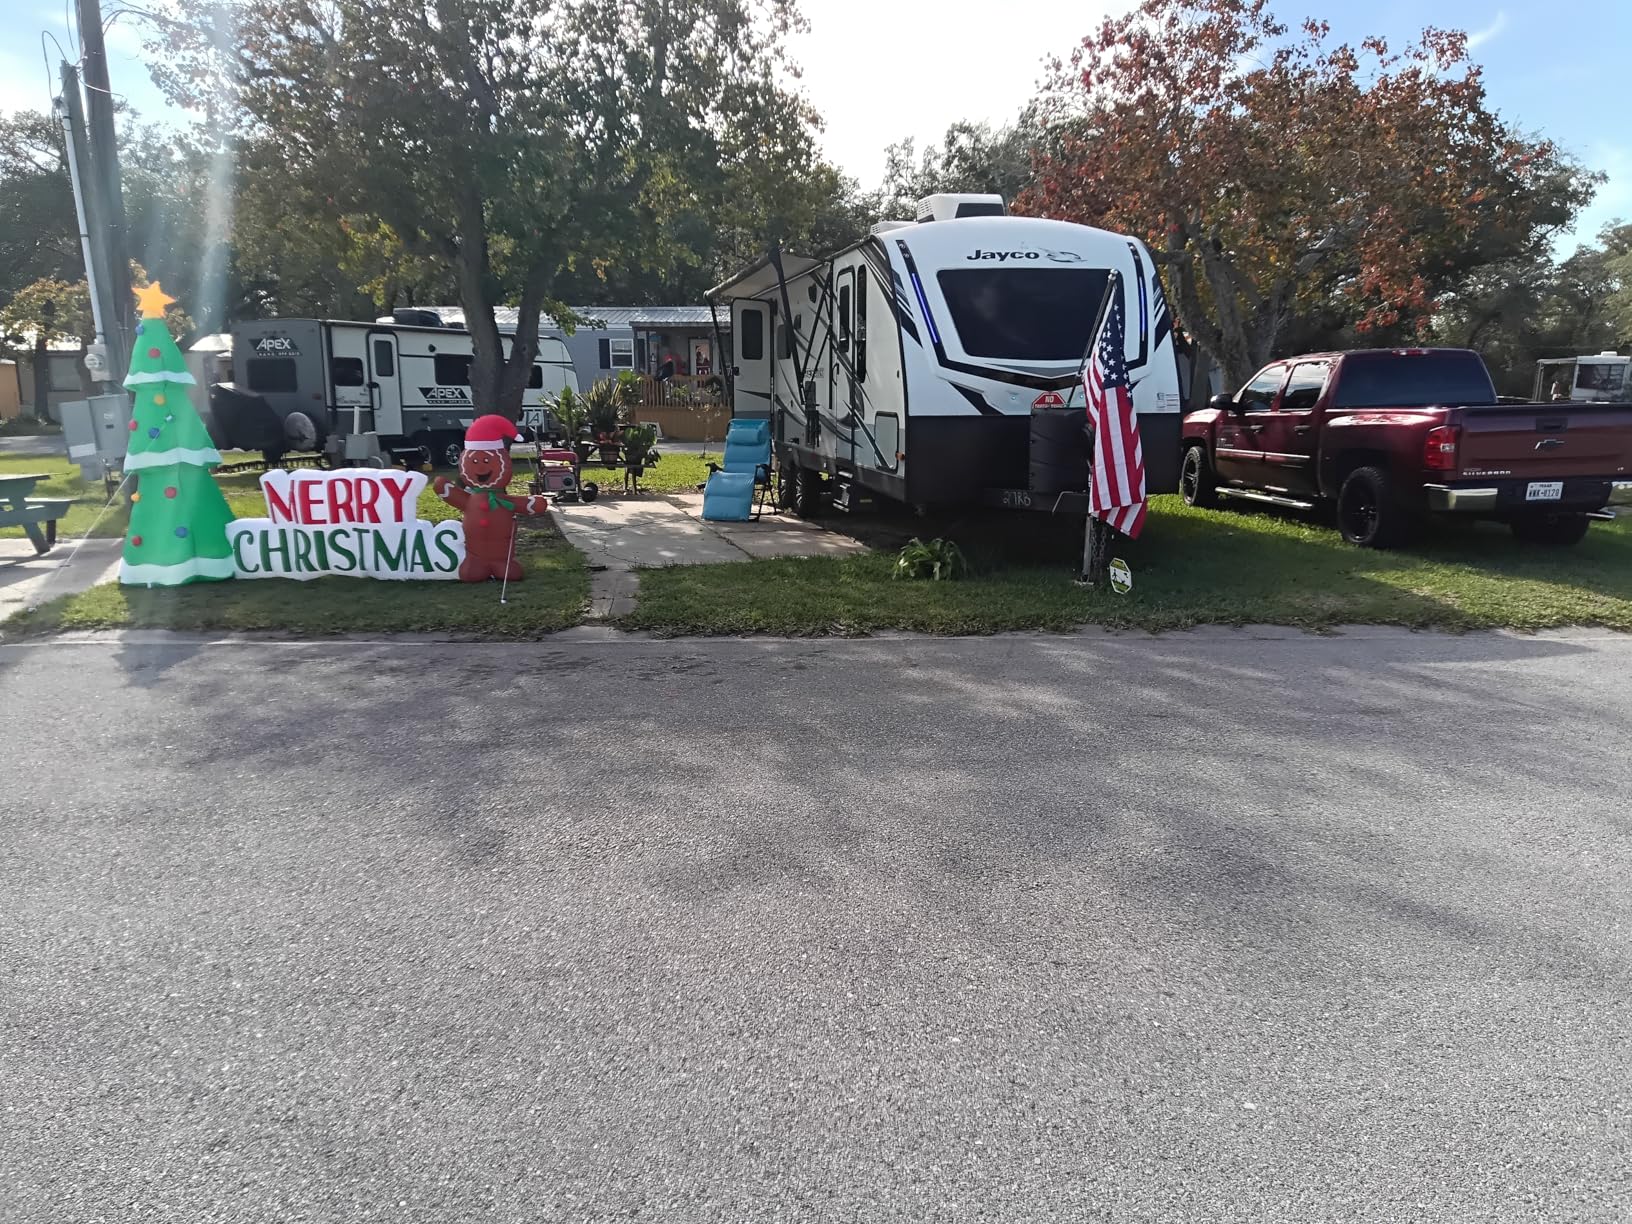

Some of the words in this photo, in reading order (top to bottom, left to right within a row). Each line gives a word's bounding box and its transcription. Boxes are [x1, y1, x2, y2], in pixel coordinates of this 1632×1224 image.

[966, 249, 1040, 262] Jayco
[256, 337, 291, 351] APEX
[426, 387, 461, 399] APEX
[1044, 395, 1055, 403] NO
[264, 478, 413, 524] MERRY
[233, 527, 459, 573] CHRISTMAS
